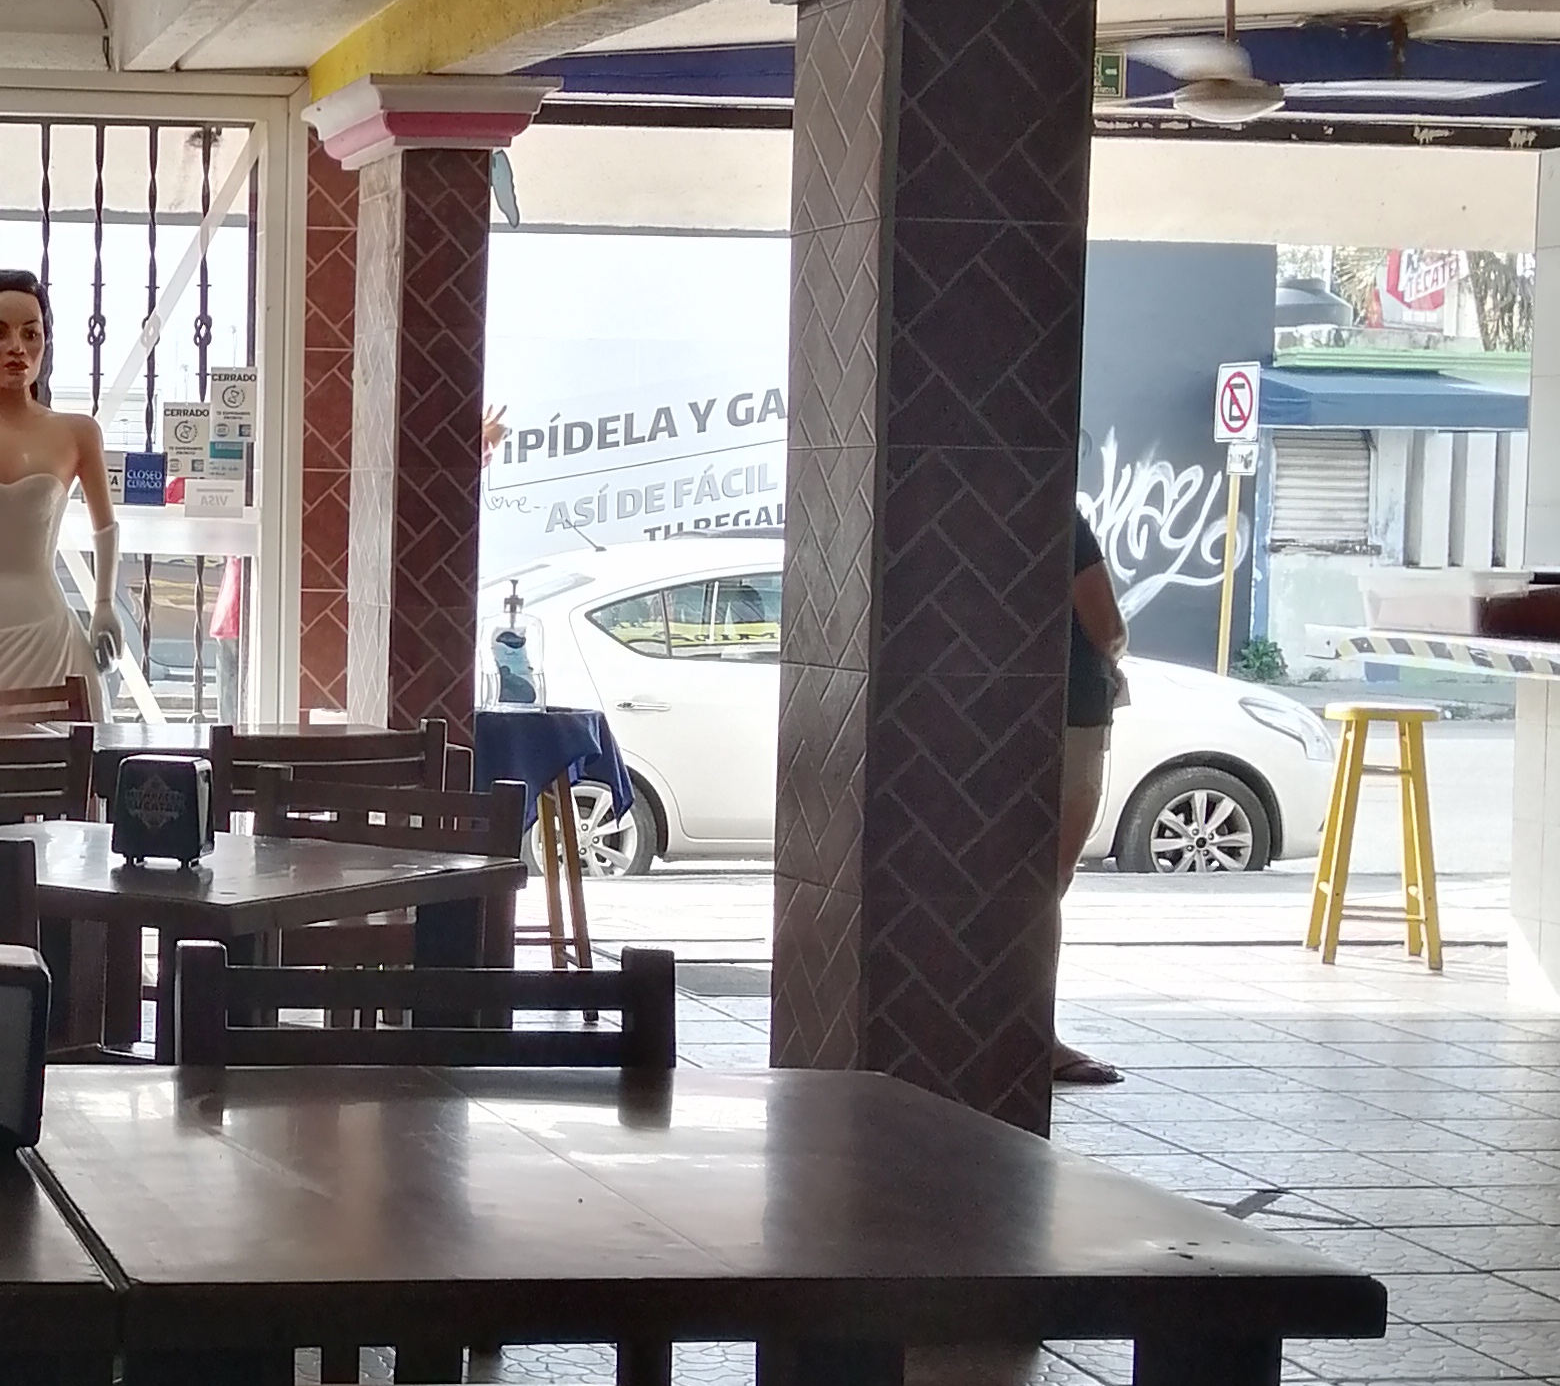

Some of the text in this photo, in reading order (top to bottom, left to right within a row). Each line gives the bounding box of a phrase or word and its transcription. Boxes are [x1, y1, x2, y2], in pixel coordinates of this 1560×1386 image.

[1406, 256, 1459, 299] TECATE
[211, 373, 258, 382] CERRADO
[163, 408, 210, 418] CERRADO
[687, 398, 717, 434] Y
[126, 469, 163, 480] CLOSED
[545, 462, 778, 533] ASÍ DE FÁCIL
